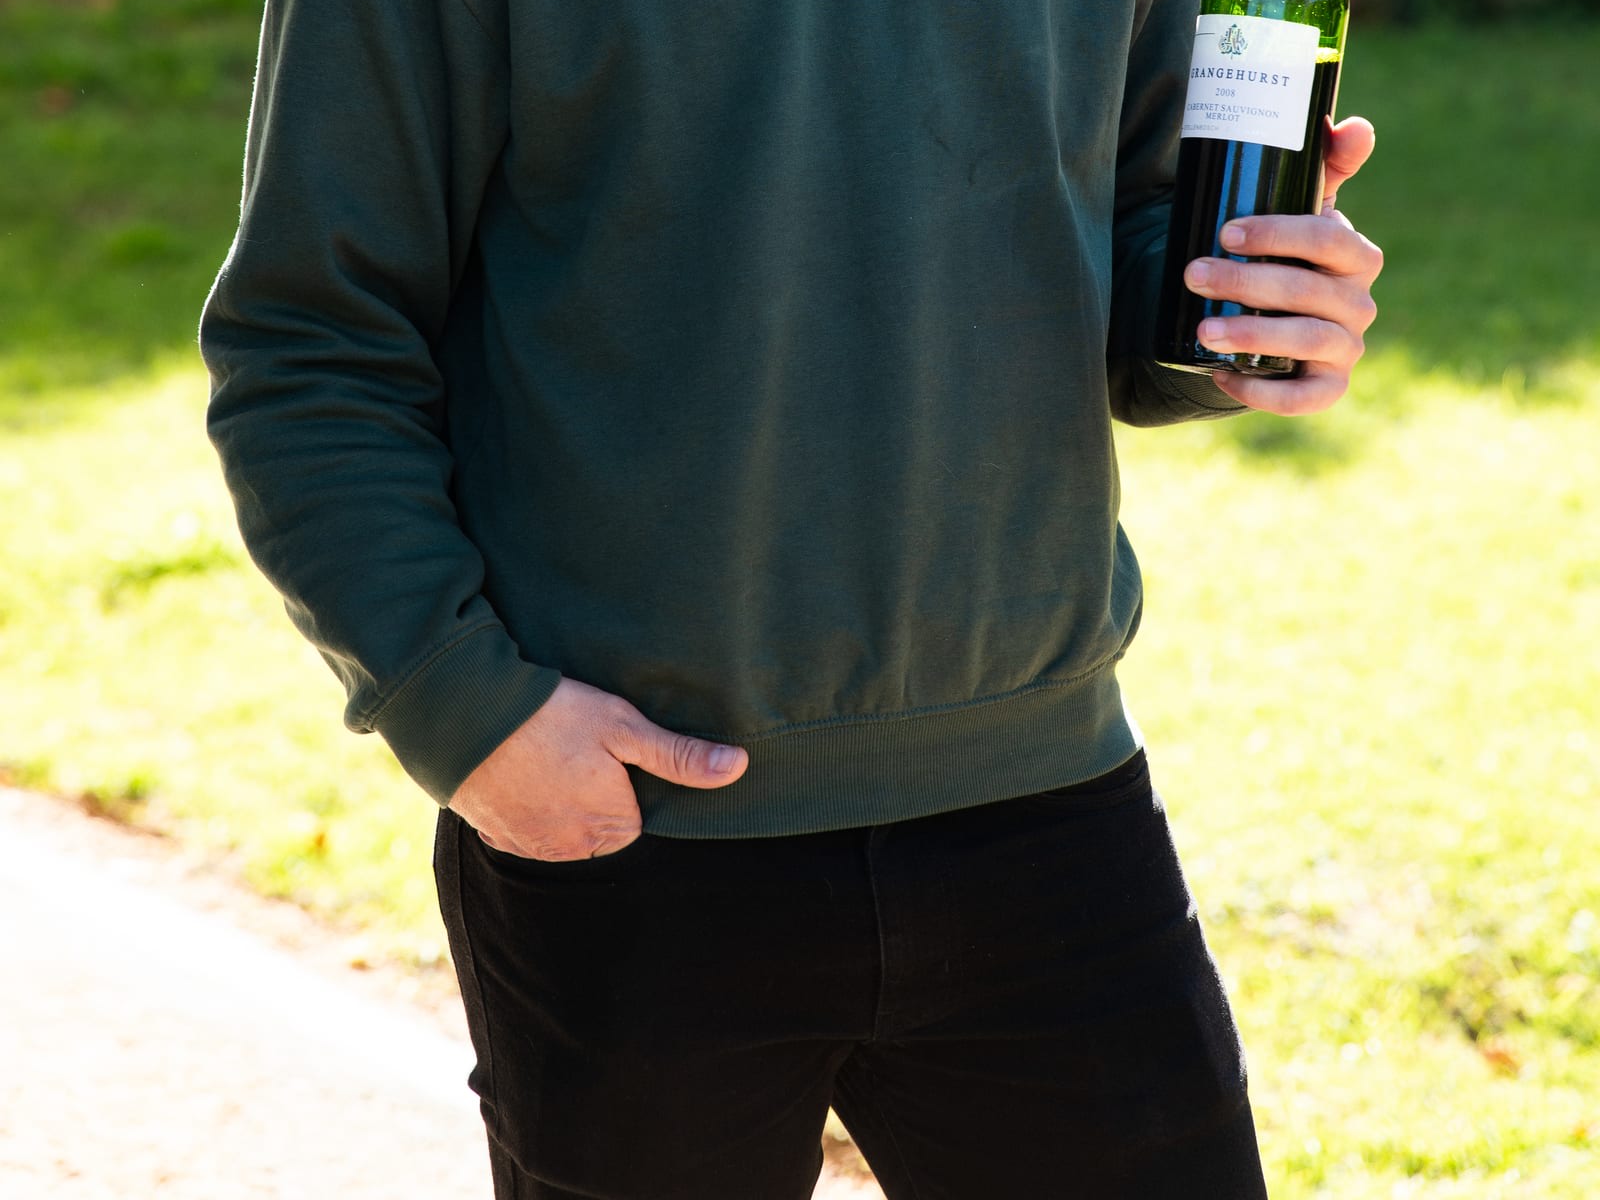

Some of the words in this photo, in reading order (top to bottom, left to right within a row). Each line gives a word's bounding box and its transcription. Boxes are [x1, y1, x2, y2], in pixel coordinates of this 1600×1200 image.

[1190, 67, 1290, 87] GRANGEHURST
[1215, 87, 1236, 98] 2008
[1186, 102, 1219, 112] CABERNET
[1220, 104, 1280, 119] SAUVIGNON
[1205, 112, 1240, 122] MERLOT
